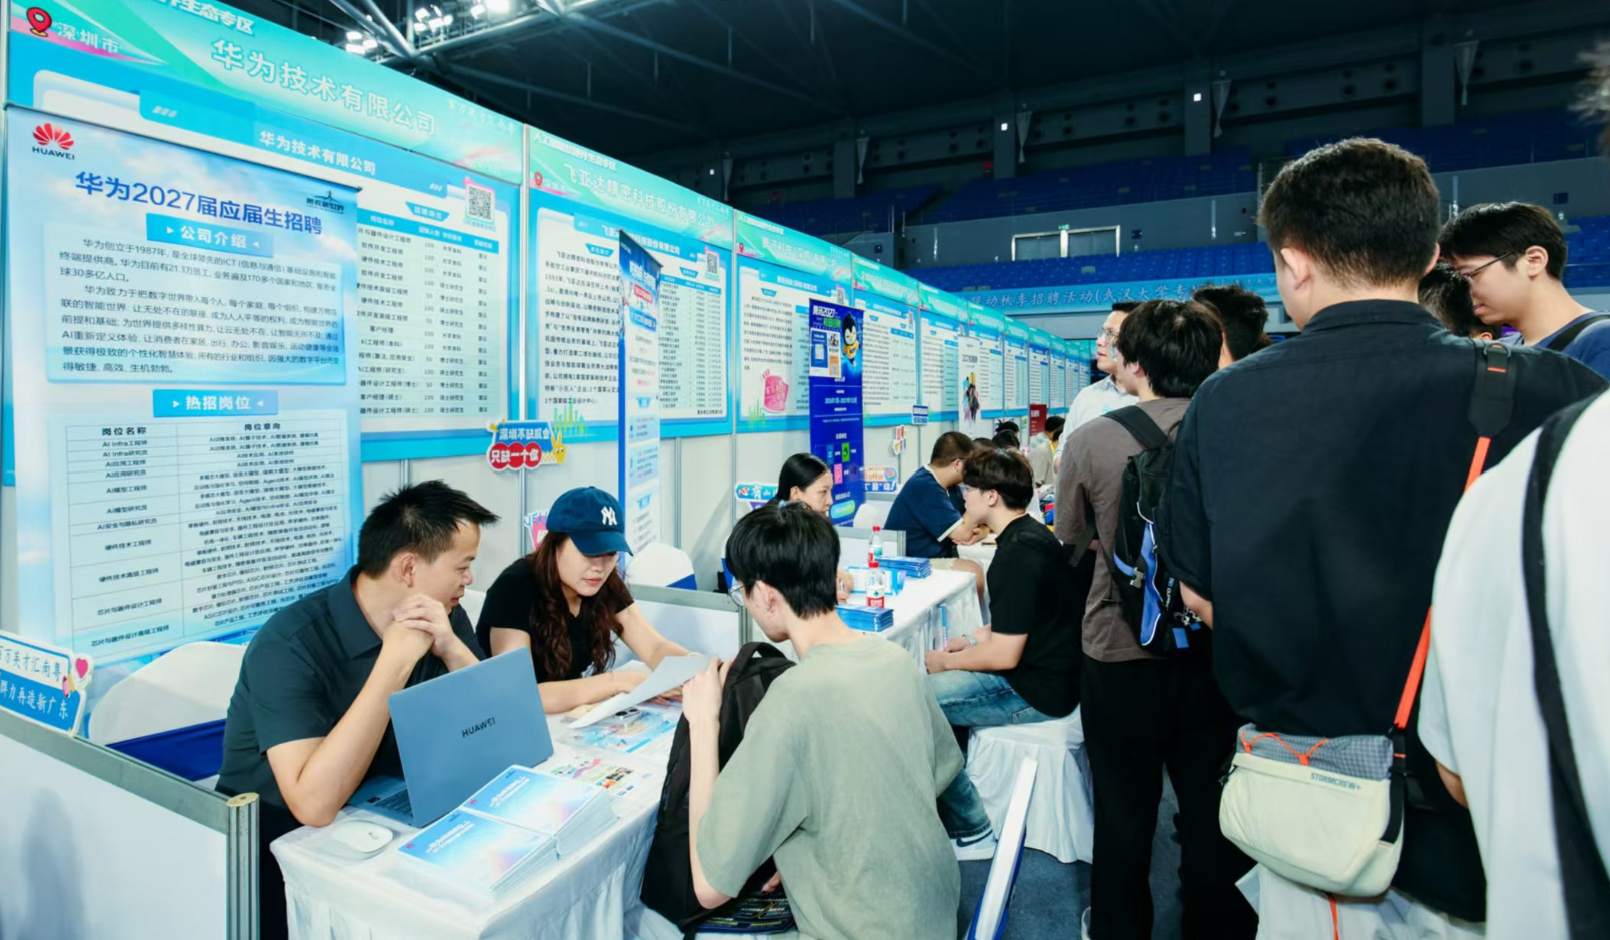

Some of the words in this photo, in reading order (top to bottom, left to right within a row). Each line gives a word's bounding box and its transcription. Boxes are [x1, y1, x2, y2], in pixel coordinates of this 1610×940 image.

[56, 21, 120, 54] 深圳市
[210, 38, 435, 136] 华为技术有限公司
[32, 146, 76, 160] HUAWEI
[260, 130, 376, 176] 华为技术有限公司
[75, 170, 323, 236] 华为2027届应届生招聘
[180, 224, 248, 250] 公司介绍
[59, 267, 130, 283] 球30多亿人口。
[185, 395, 252, 411] 热招岗位
[101, 426, 147, 437] 岗位名称
[244, 421, 282, 431] 岗位意向
[499, 427, 550, 441] 深圳不缺机会
[101, 440, 110, 448] AI
[105, 459, 147, 468] AI应用工程师
[491, 449, 539, 464] 只缺一个你
[105, 469, 147, 479] AI应用研究员
[105, 485, 148, 495] AI模型工程师
[106, 504, 148, 515] AI模型研究员
[600, 506, 617, 525] NY
[105, 538, 153, 551] 硬件技术工程师
[98, 566, 159, 583] 硬件技术高级工程师
[462, 717, 496, 738] HUAWEI
